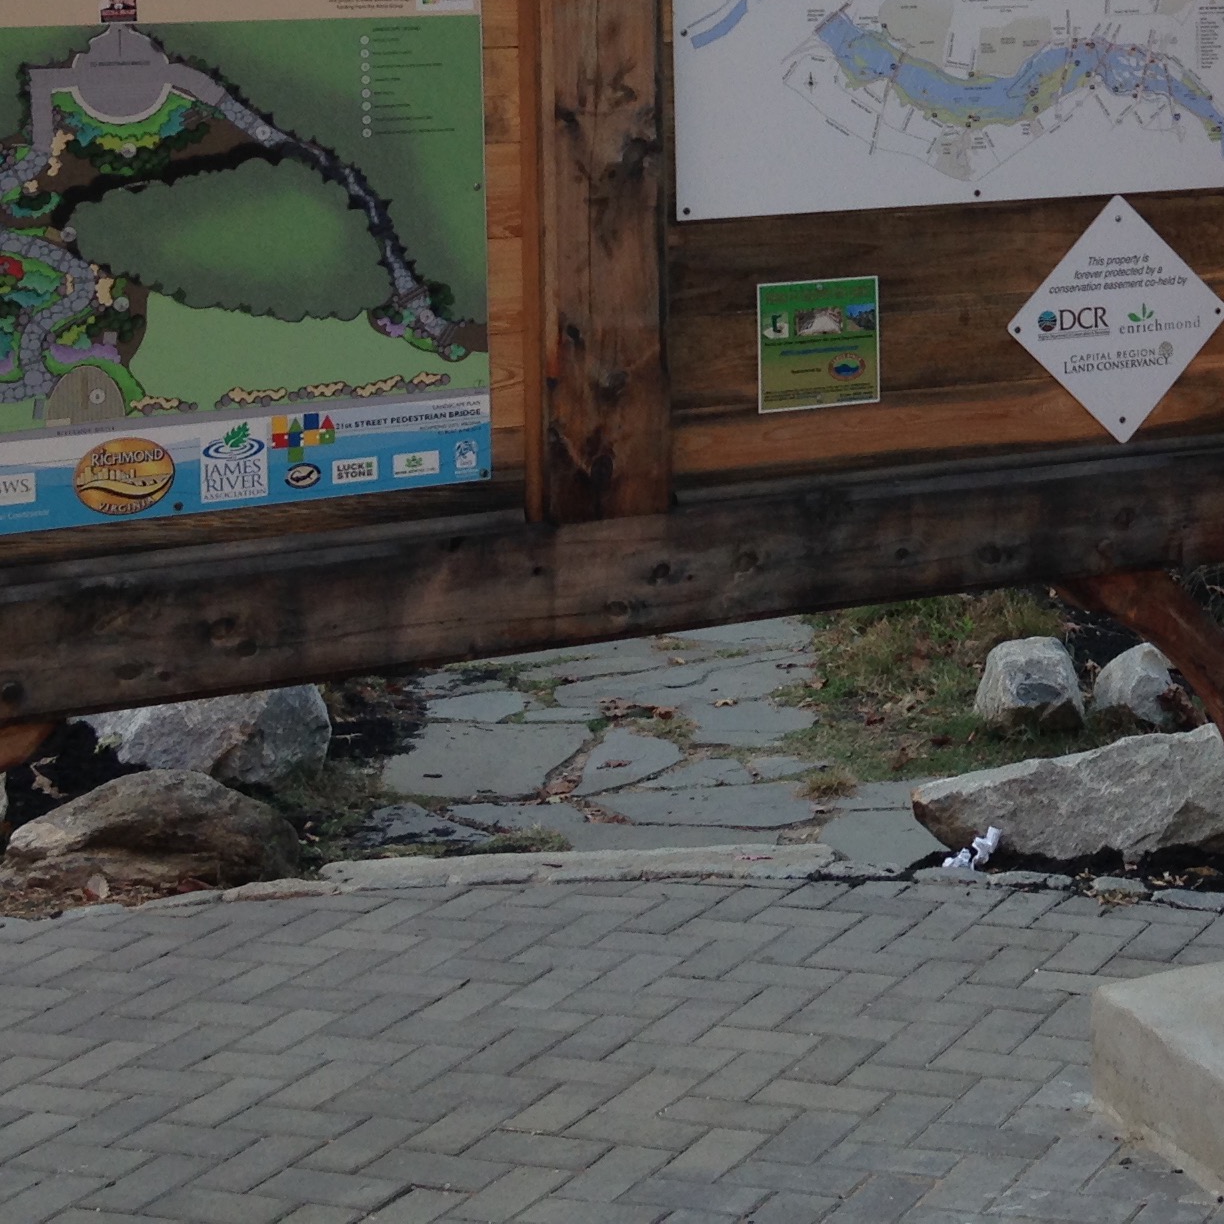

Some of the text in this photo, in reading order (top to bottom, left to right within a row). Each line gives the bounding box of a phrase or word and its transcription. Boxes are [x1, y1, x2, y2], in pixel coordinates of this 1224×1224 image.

[1088, 254, 1149, 266] This property is
[1074, 270, 1102, 279] forever
[1104, 267, 1142, 278] protected
[1145, 265, 1155, 275] by
[1049, 276, 1188, 294] conservation easement co-held by
[1059, 307, 1109, 331] DCR
[1119, 316, 1200, 334] enrichmond
[1070, 348, 1156, 363] CAPITAL REGION
[1063, 355, 1170, 374] LAND CONSERVANCY
[355, 418, 387, 428] STREET
[391, 412, 446, 424] PEDESTRIAN
[448, 409, 481, 418] BRIDGE
[91, 449, 164, 466] RICHMOND
[205, 459, 261, 481] JAMES
[337, 462, 364, 472] LUCK
[337, 469, 373, 479] STONE
[207, 474, 262, 492] RIVER
[204, 489, 266, 500] ASSOCIATION
[98, 496, 155, 513] VIRGINIA
